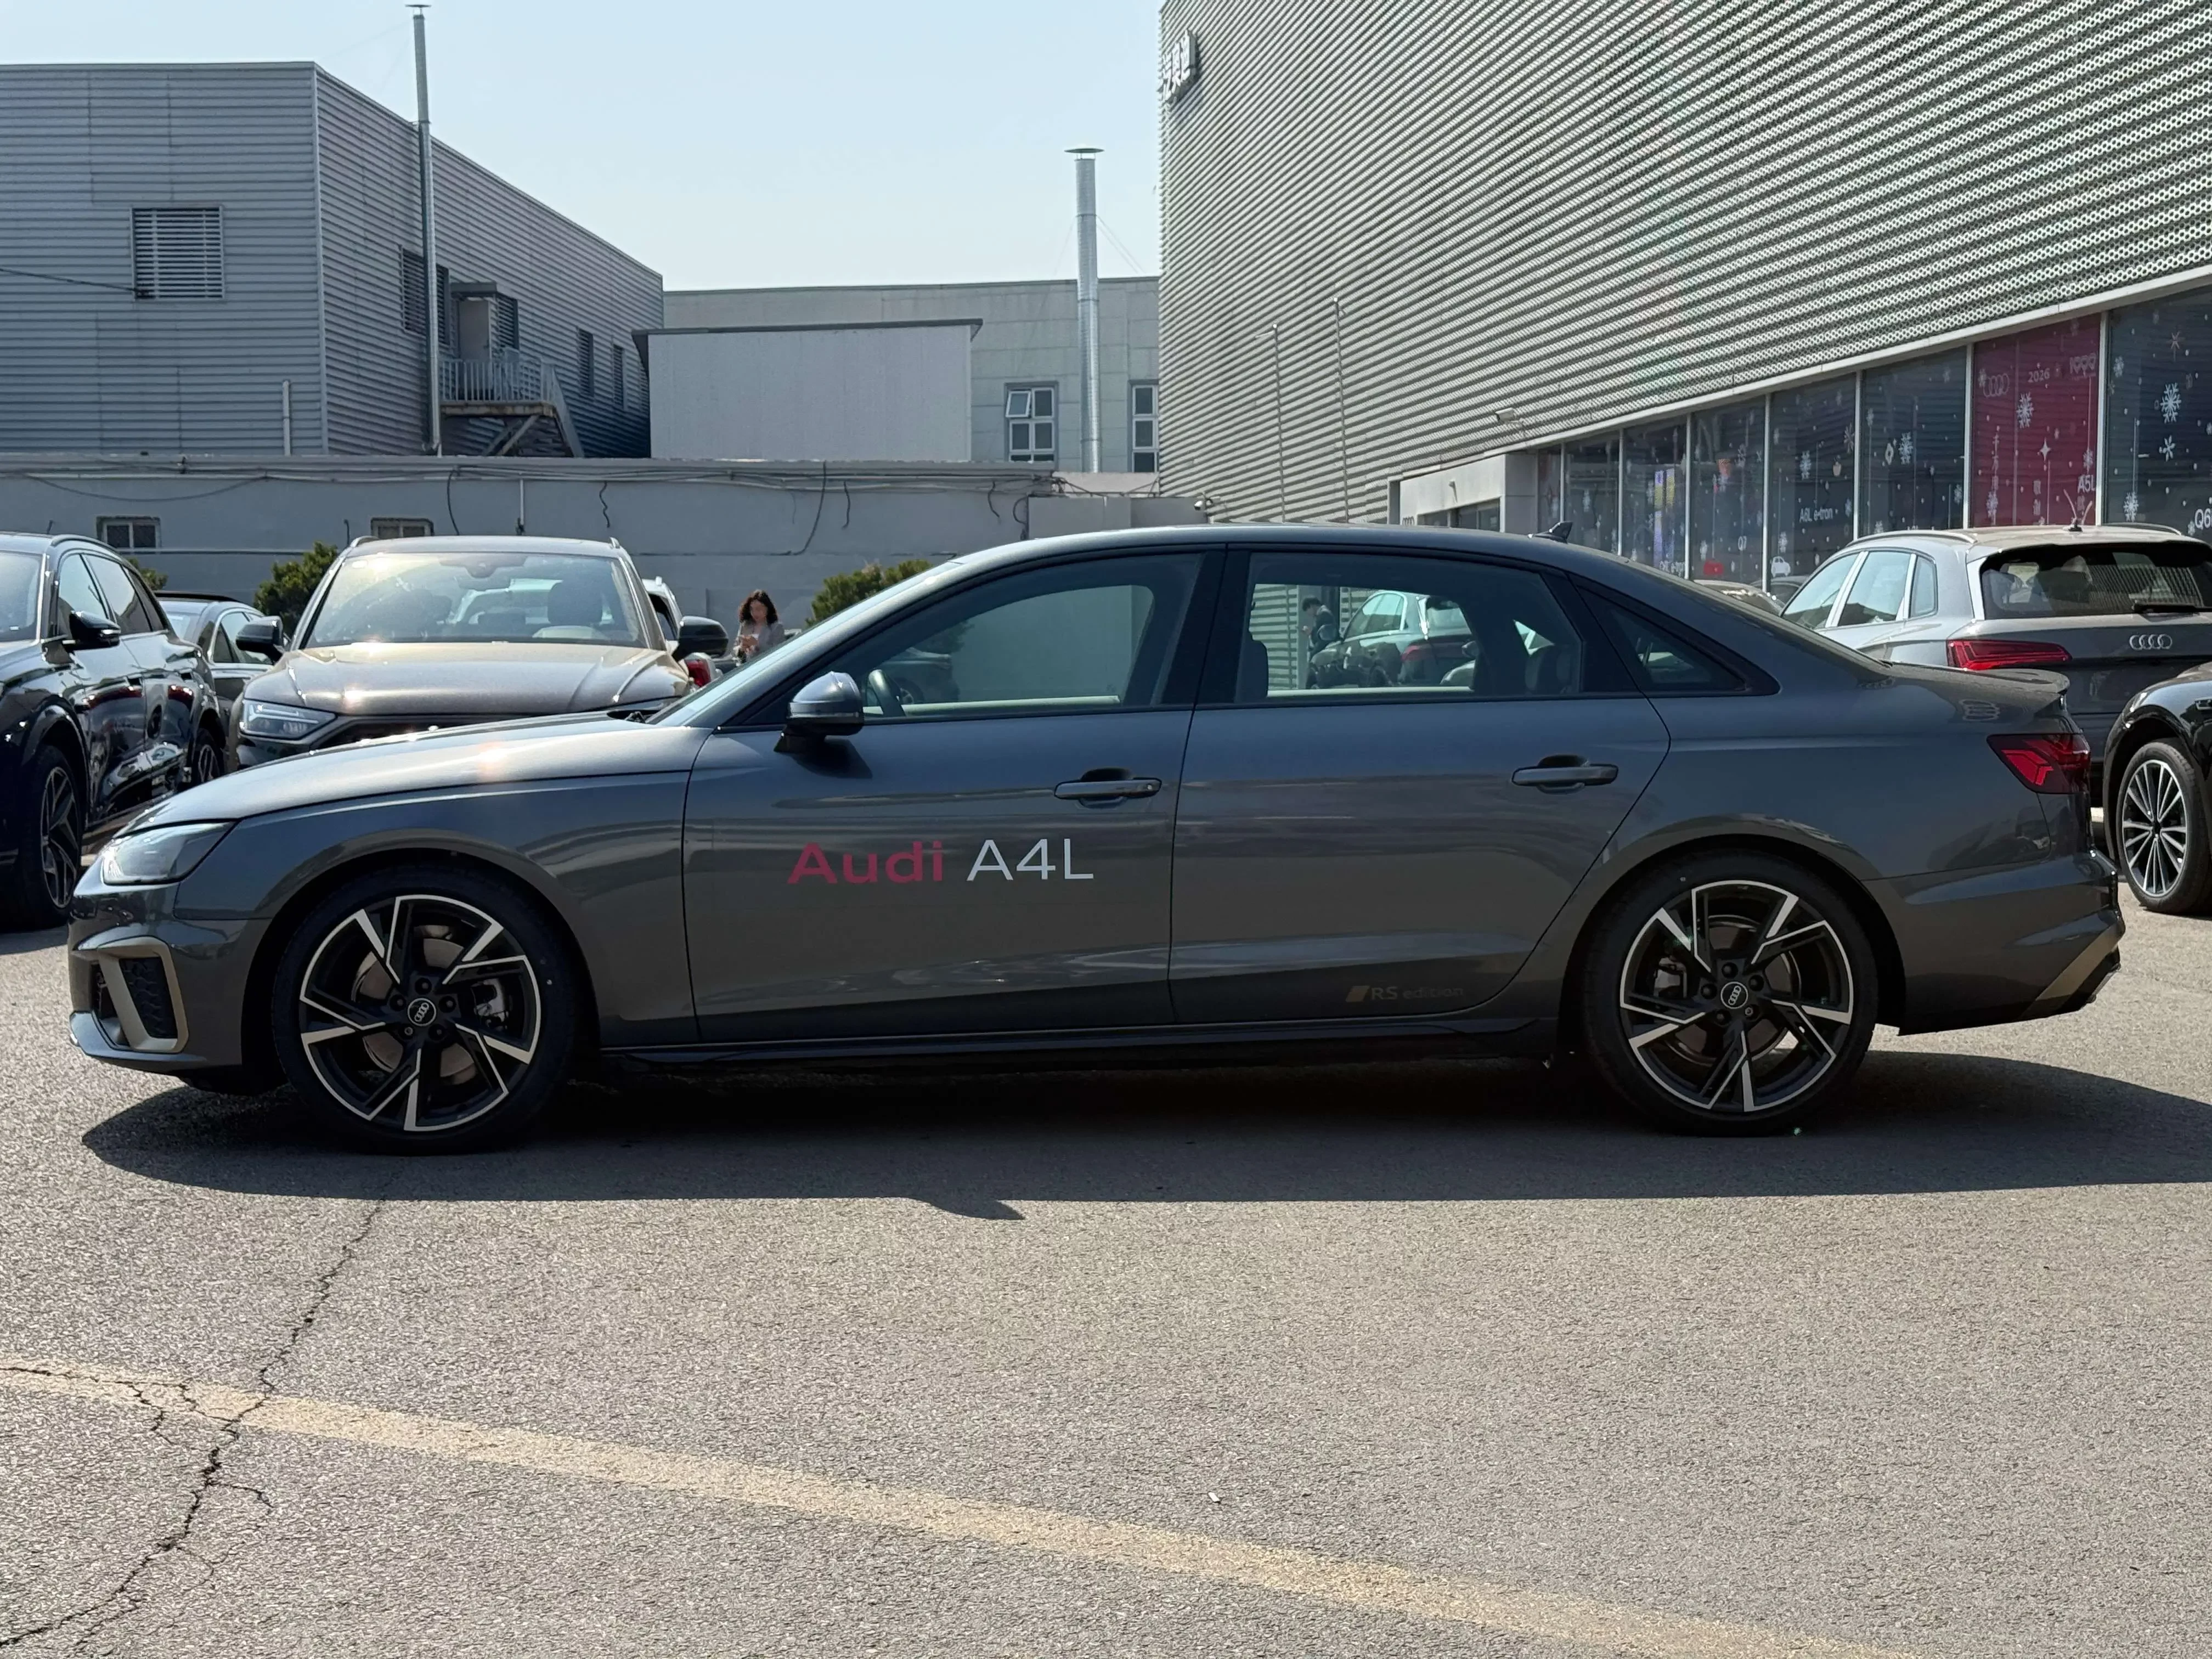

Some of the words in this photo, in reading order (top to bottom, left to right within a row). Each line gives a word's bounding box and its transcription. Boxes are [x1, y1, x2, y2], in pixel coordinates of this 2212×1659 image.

[2028, 368, 2050, 383] 2026
[2194, 508, 2212, 531] Q6
[787, 840, 944, 884] Audi
[966, 838, 1094, 881] A4L
[1371, 986, 1398, 1000] RS
[1402, 987, 1464, 1000] edition
